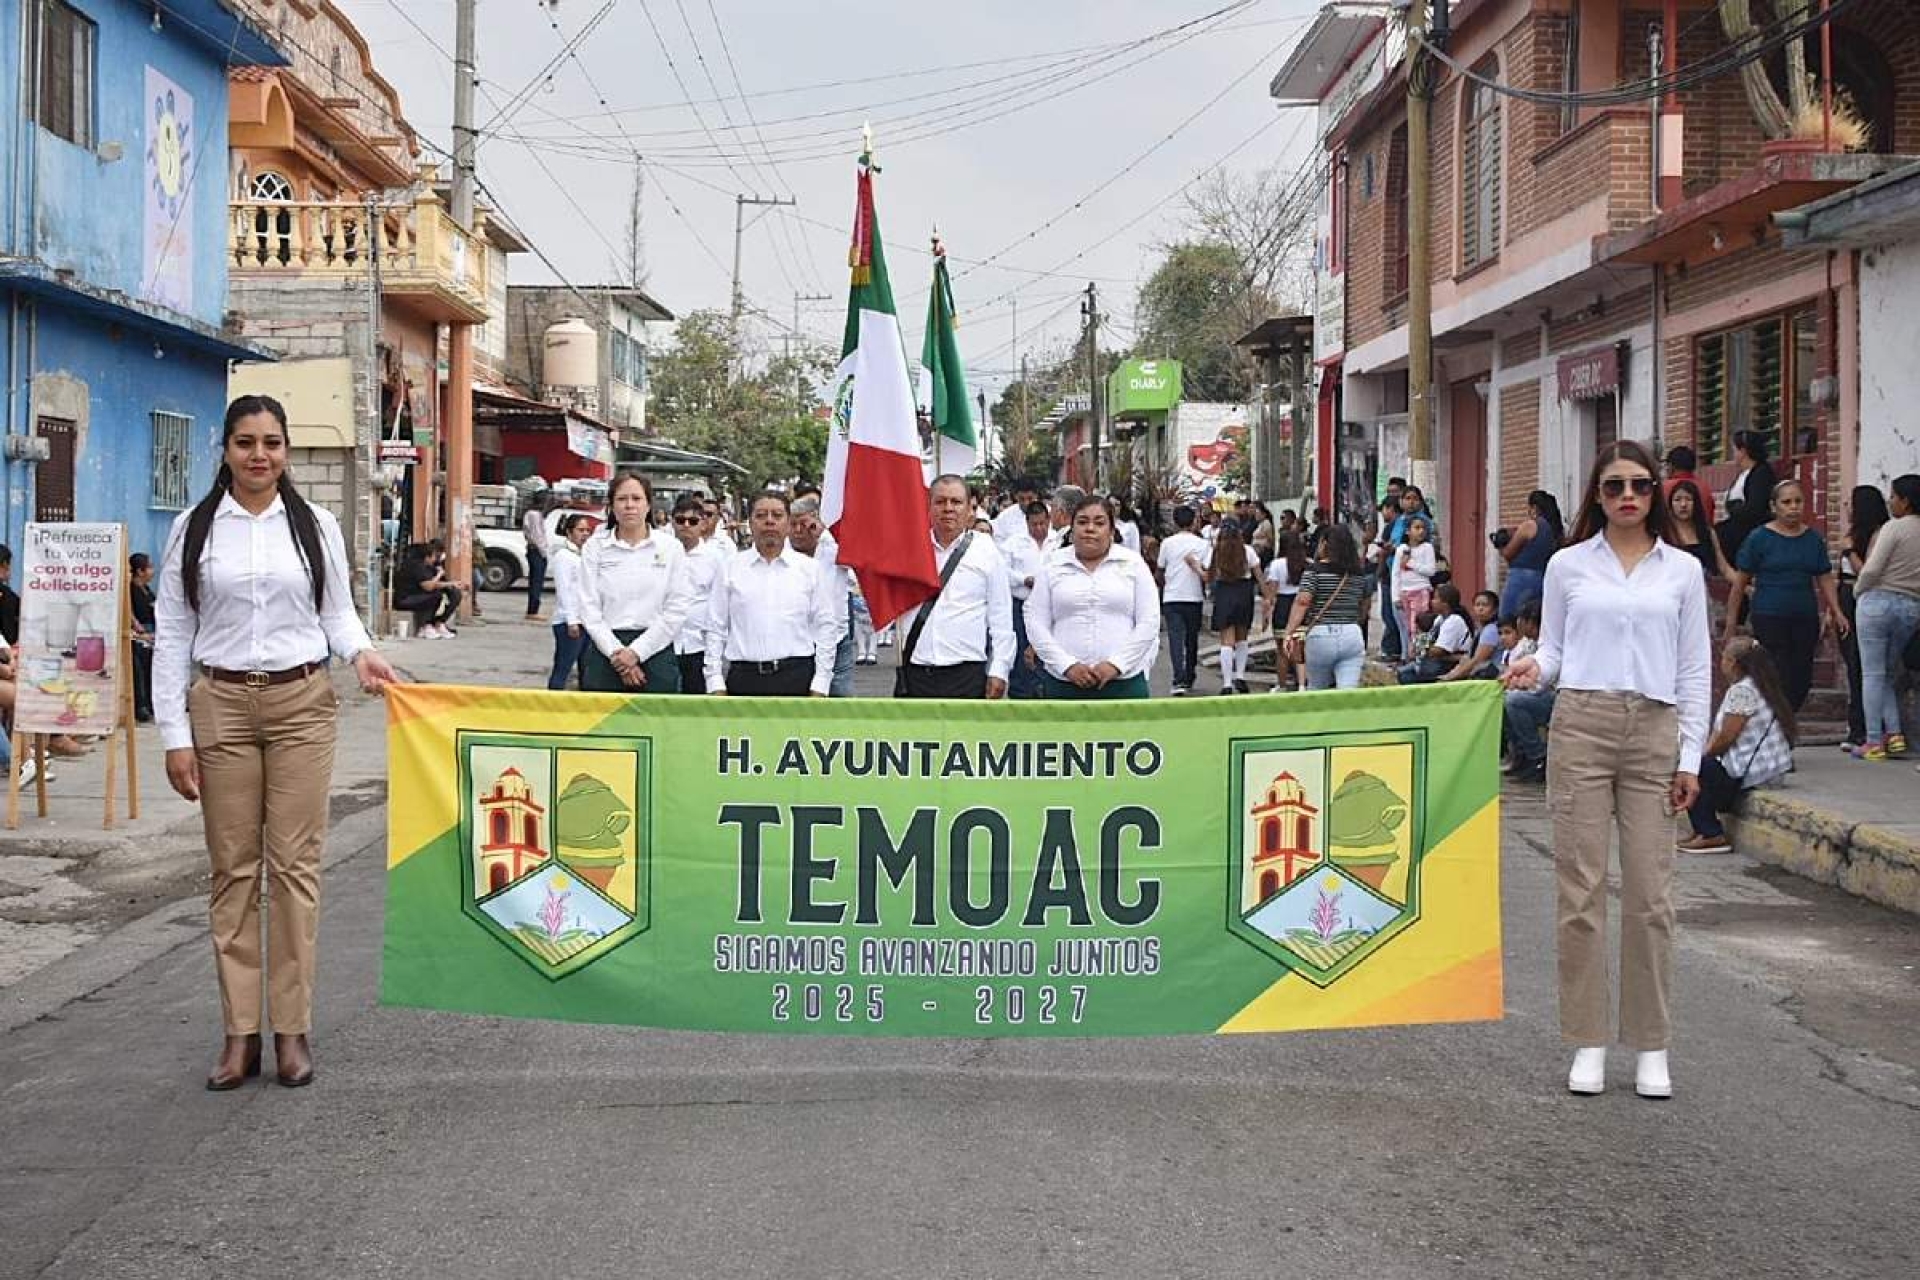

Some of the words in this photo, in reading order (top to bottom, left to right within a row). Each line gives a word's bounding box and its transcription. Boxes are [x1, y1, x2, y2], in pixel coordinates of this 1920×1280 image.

[33, 529, 112, 545] ¡Refresca
[44, 548, 62, 559] tu
[67, 547, 102, 559] vida
[29, 578, 114, 591] delicioso!
[33, 565, 67, 575] con
[71, 563, 112, 578] algo
[718, 738, 763, 776] H.
[776, 740, 1162, 779] AYUNTAMIENTO
[717, 804, 1162, 928] TEMOAC
[714, 935, 846, 974] SIGAMOS
[860, 938, 1037, 976] AVANZANDO
[1048, 937, 1161, 976] JUNTOS
[773, 984, 884, 1021] 2025
[975, 985, 1087, 1024] 2027
